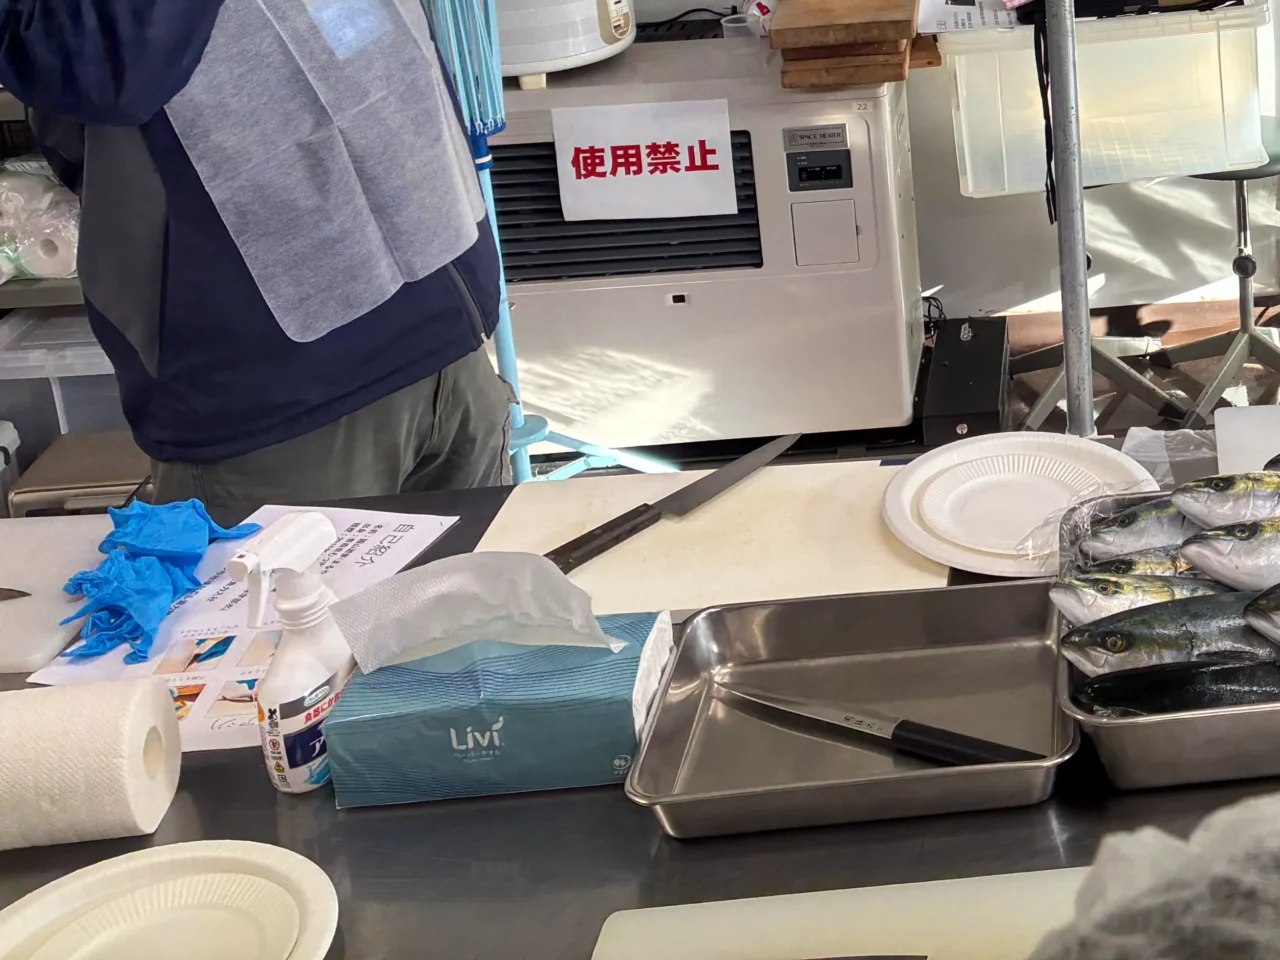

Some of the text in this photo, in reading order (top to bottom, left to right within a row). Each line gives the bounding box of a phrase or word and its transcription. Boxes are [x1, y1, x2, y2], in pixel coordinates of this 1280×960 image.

[856, 102, 869, 111] 22
[571, 140, 720, 180] 使用禁止
[354, 523, 415, 568] 自己紹介
[450, 715, 505, 751] Livi
